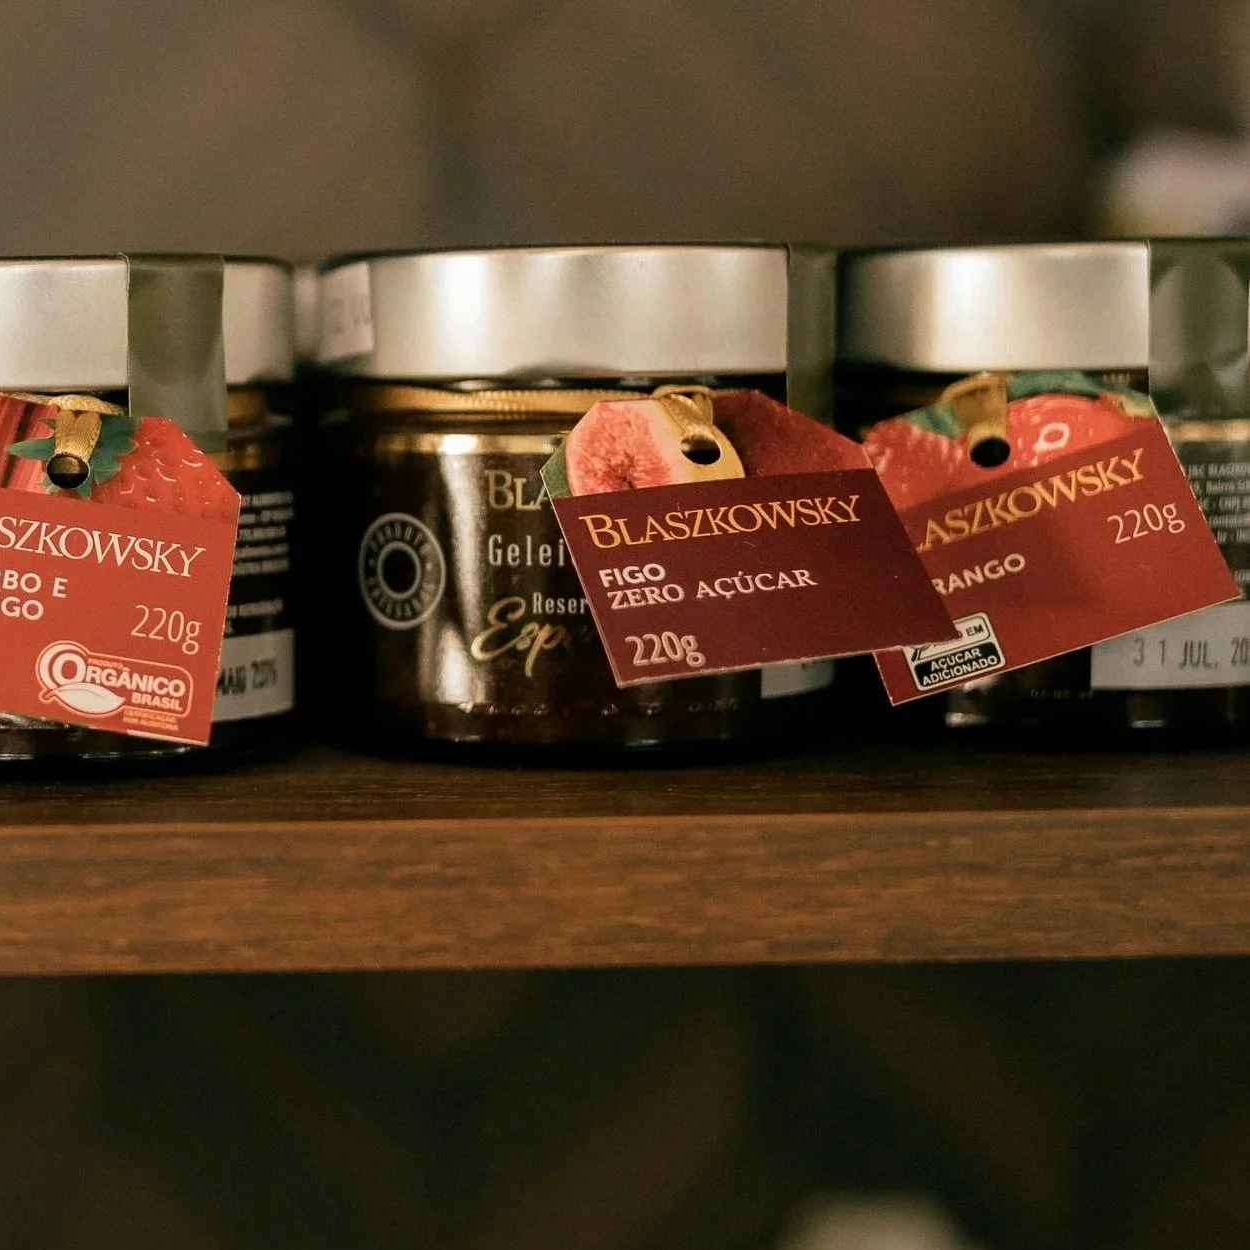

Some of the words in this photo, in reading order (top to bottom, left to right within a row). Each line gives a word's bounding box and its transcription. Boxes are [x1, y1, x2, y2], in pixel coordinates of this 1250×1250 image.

[579, 495, 861, 549] BLASZKOWSKY
[1107, 502, 1186, 545] 220g
[53, 577, 69, 598] E
[599, 563, 667, 588] FIGO
[607, 583, 685, 610] ZERO
[695, 569, 818, 600] AÇÚCAR
[131, 604, 202, 655] 220g
[624, 631, 706, 668] 220g
[52, 652, 186, 698] ORGÂNICO
[922, 655, 998, 686] ADICIONADO
[131, 692, 183, 711] BRASIL
